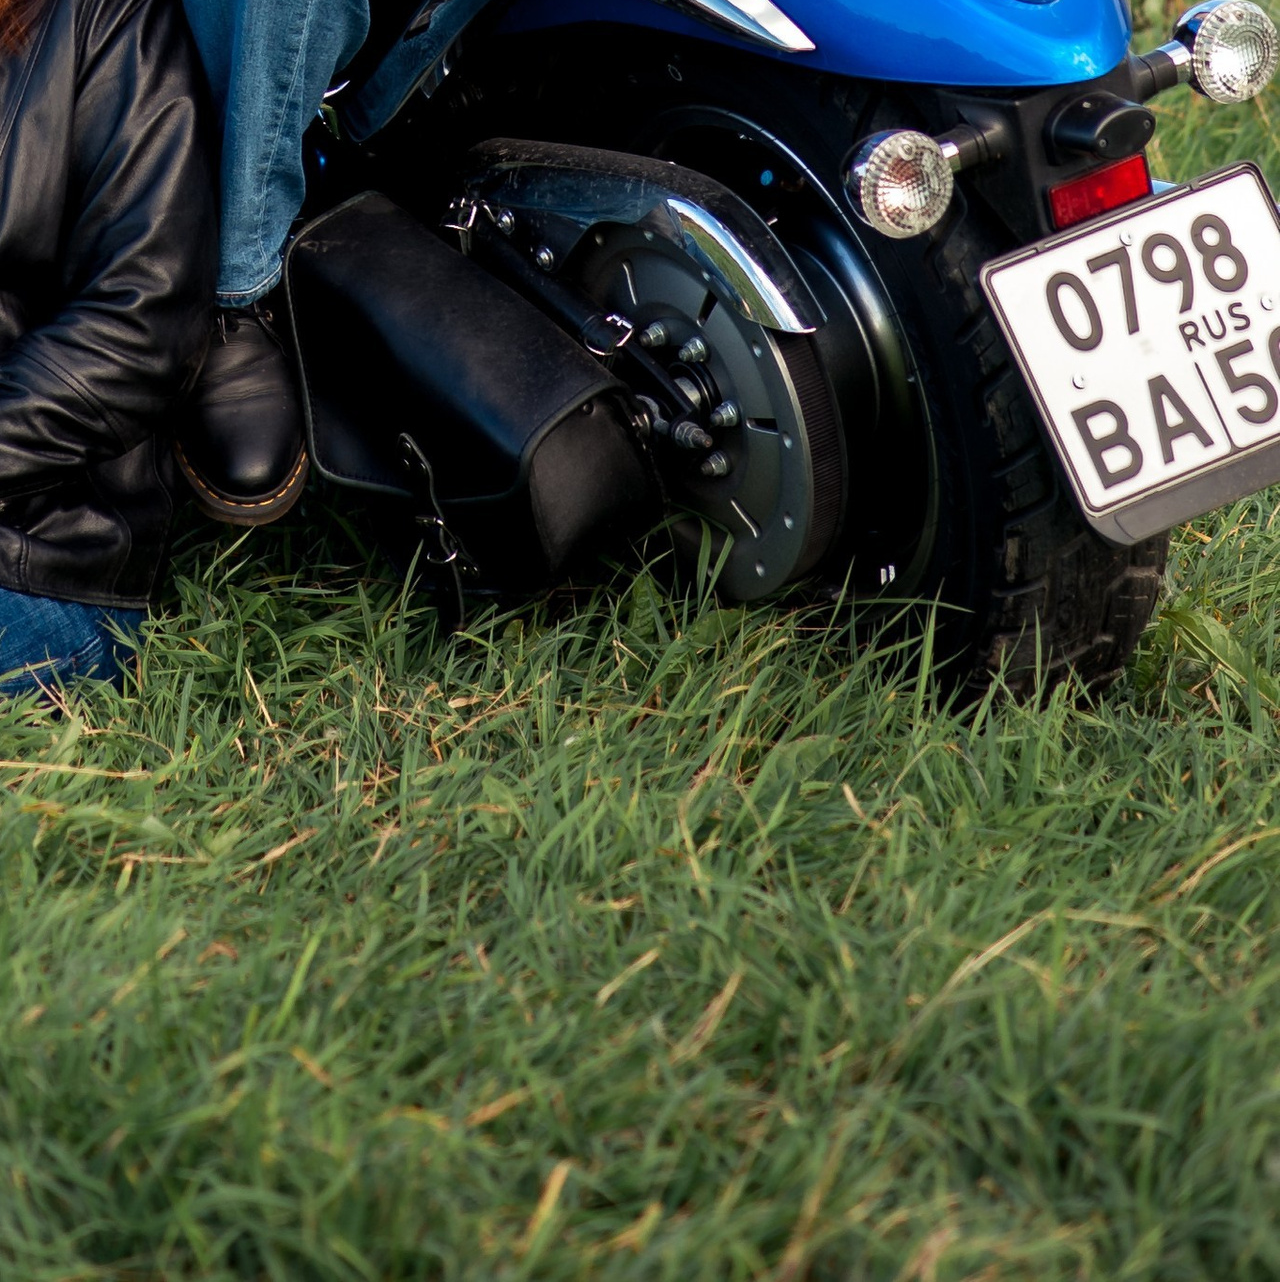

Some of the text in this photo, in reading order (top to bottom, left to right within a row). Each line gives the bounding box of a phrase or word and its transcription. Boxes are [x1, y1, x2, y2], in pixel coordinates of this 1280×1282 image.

[1046, 213, 1249, 352] 0798
[1179, 302, 1251, 352] RUS
[1070, 325, 1280, 490] BA 5
